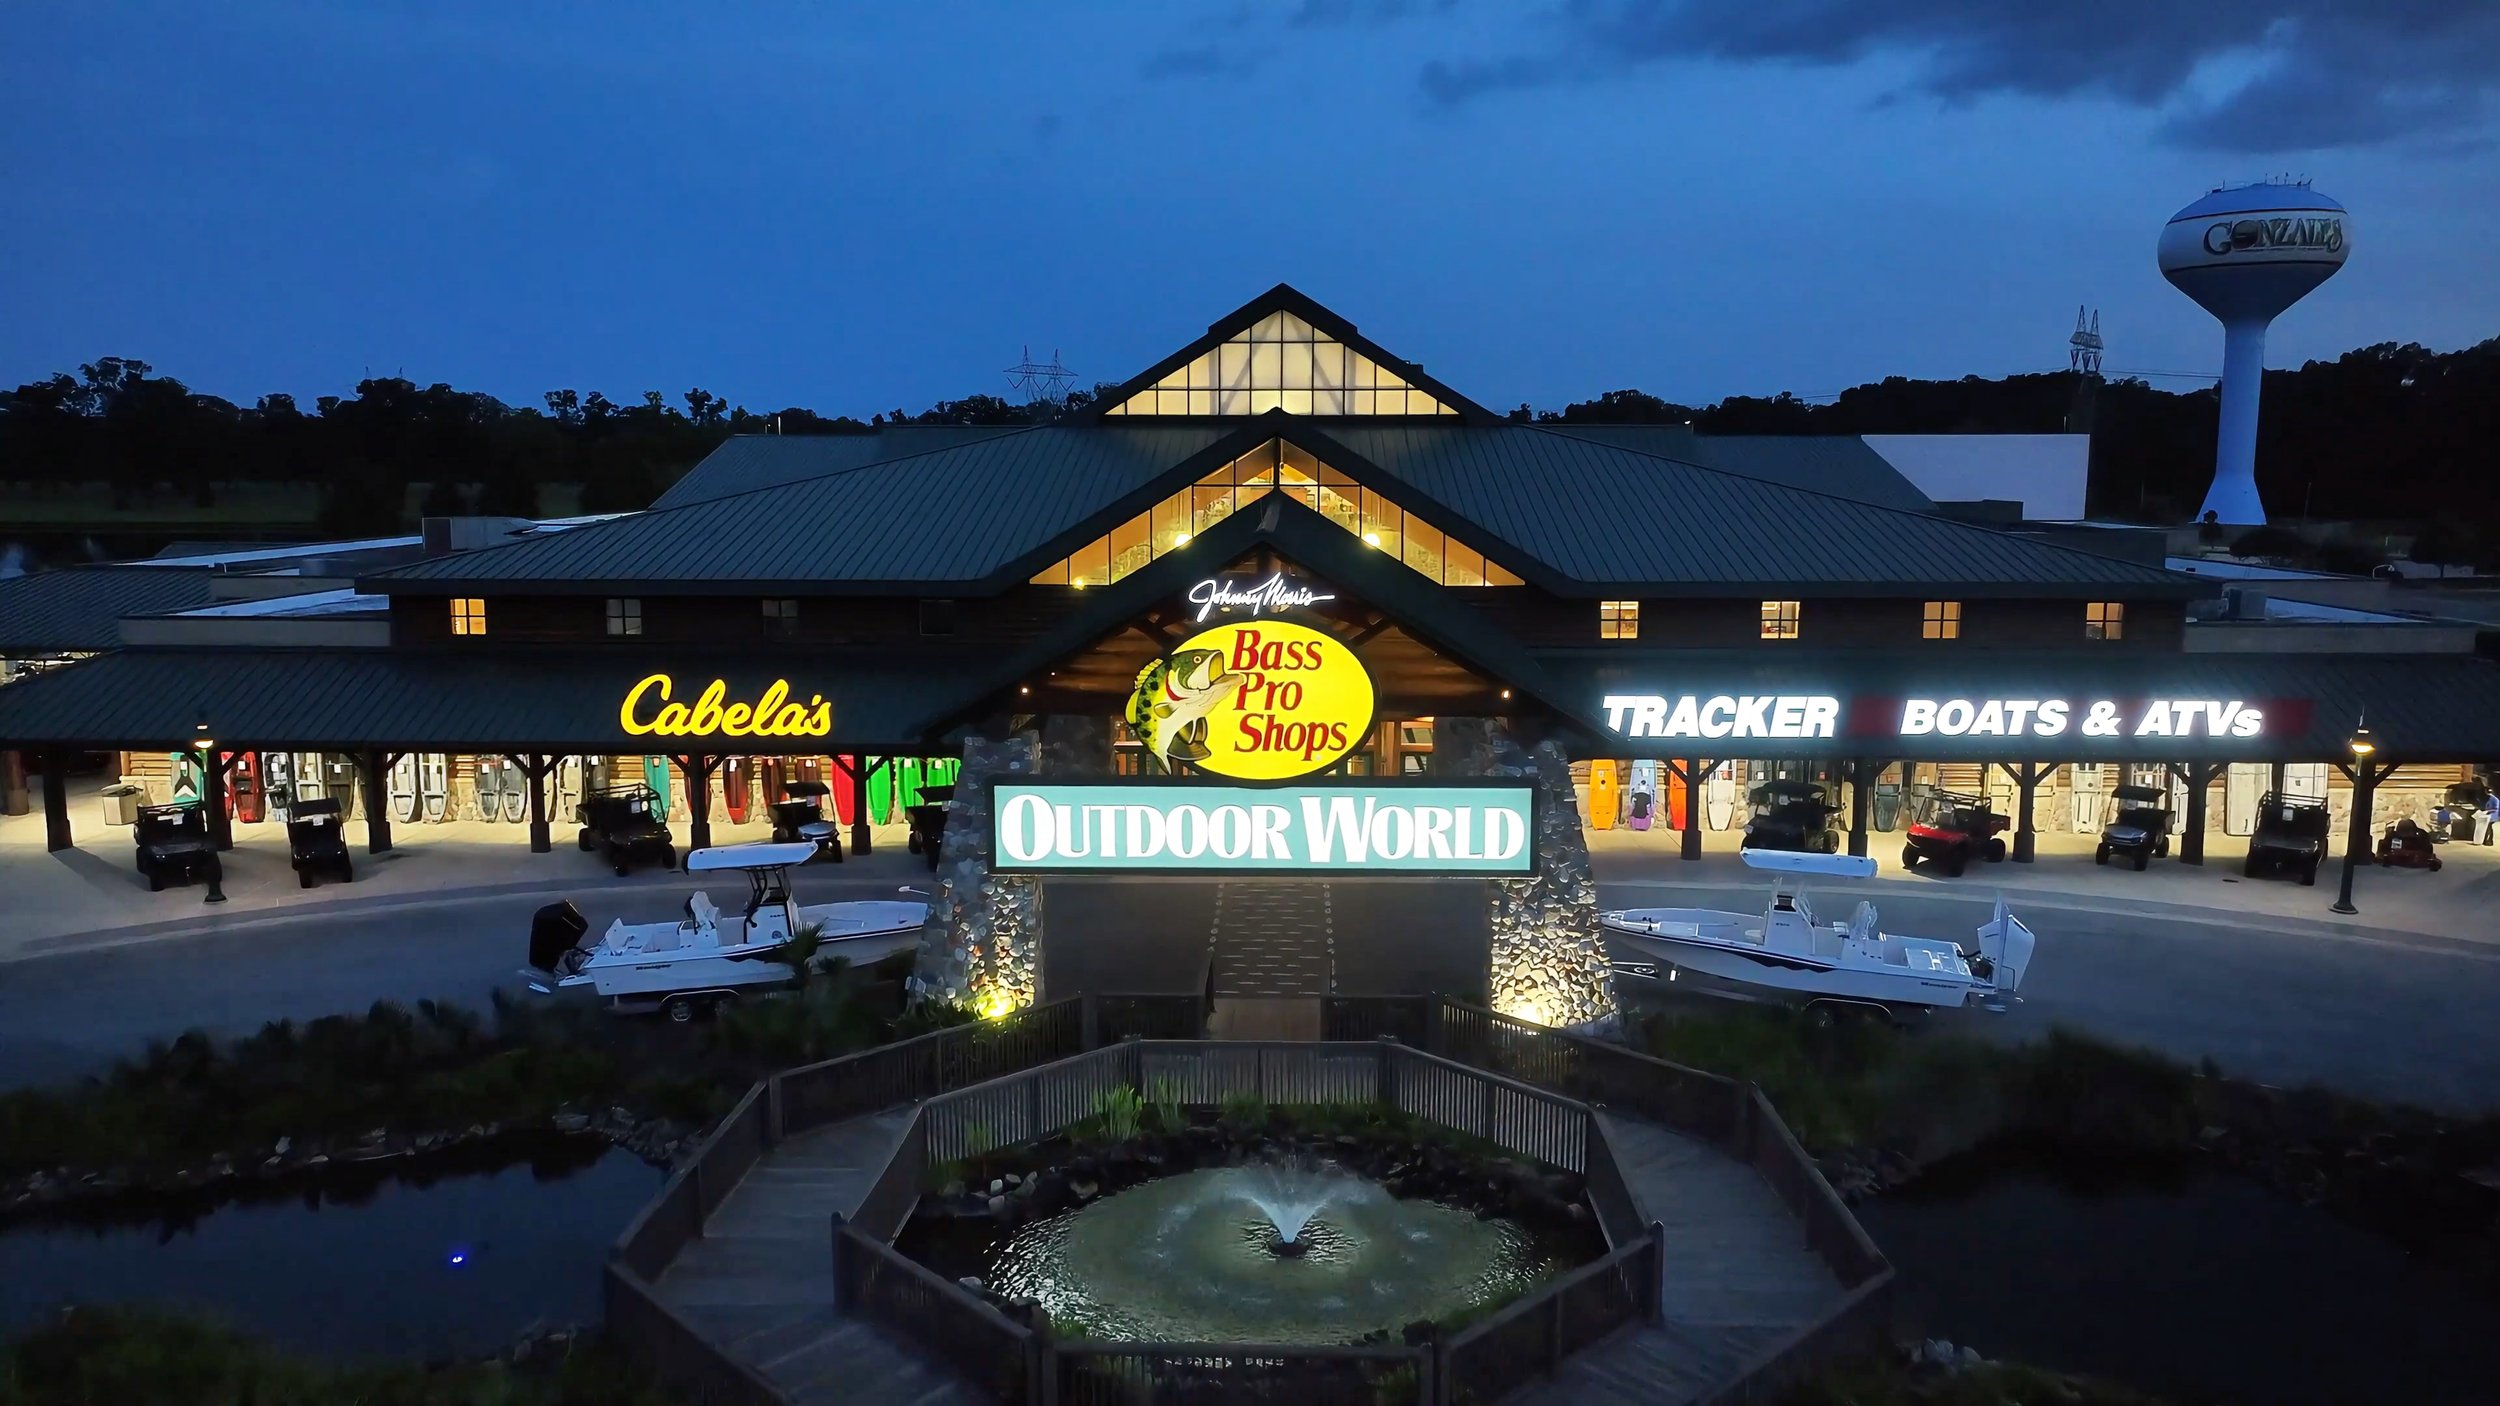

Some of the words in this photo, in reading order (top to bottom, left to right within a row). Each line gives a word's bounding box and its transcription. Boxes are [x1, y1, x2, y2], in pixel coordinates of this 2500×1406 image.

[1188, 580, 1263, 622] Johnny
[1259, 572, 1335, 606] Morris
[1228, 629, 1323, 671] Bass
[620, 673, 831, 736] Cabela's
[1232, 672, 1303, 711] Pro
[1234, 712, 1348, 761] Shops
[1602, 695, 1840, 738] TRACKER
[1900, 699, 2070, 736] BOATS
[2080, 699, 2122, 737] &
[2134, 700, 2263, 737] ATVs
[1000, 794, 1292, 862] OUTDOOR
[1300, 796, 1525, 863] WORLD
